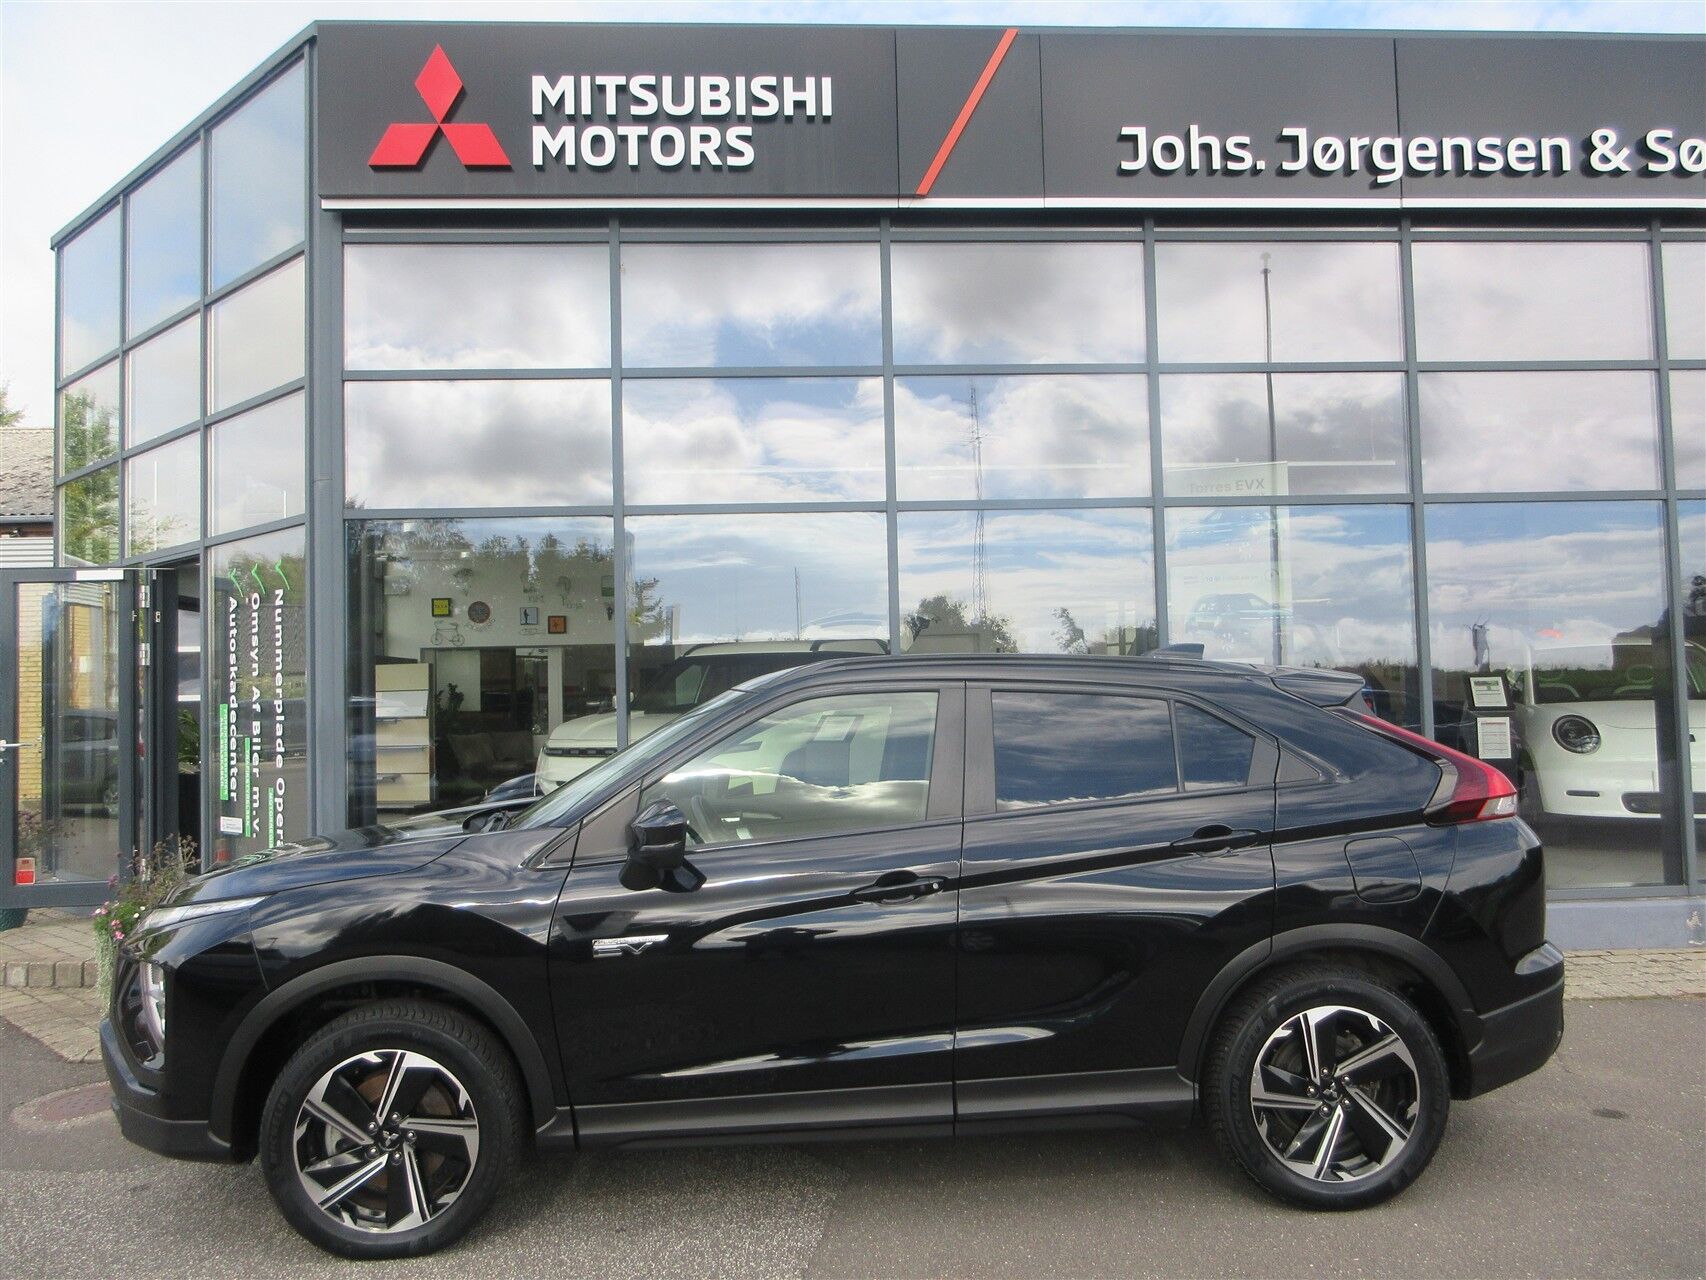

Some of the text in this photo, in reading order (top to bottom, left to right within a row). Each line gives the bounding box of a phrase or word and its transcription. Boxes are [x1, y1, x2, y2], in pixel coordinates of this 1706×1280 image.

[531, 75, 832, 117] MITSUBISHI
[531, 124, 755, 167] MOTORS
[1119, 124, 1706, 183] Johs. Jørgensen & Sø
[1235, 479, 1265, 491] EVX
[229, 596, 238, 802] Autoskadecenter
[274, 589, 285, 768] Nummerplade
[250, 592, 261, 838] Omsyn Af Biler m.v.
